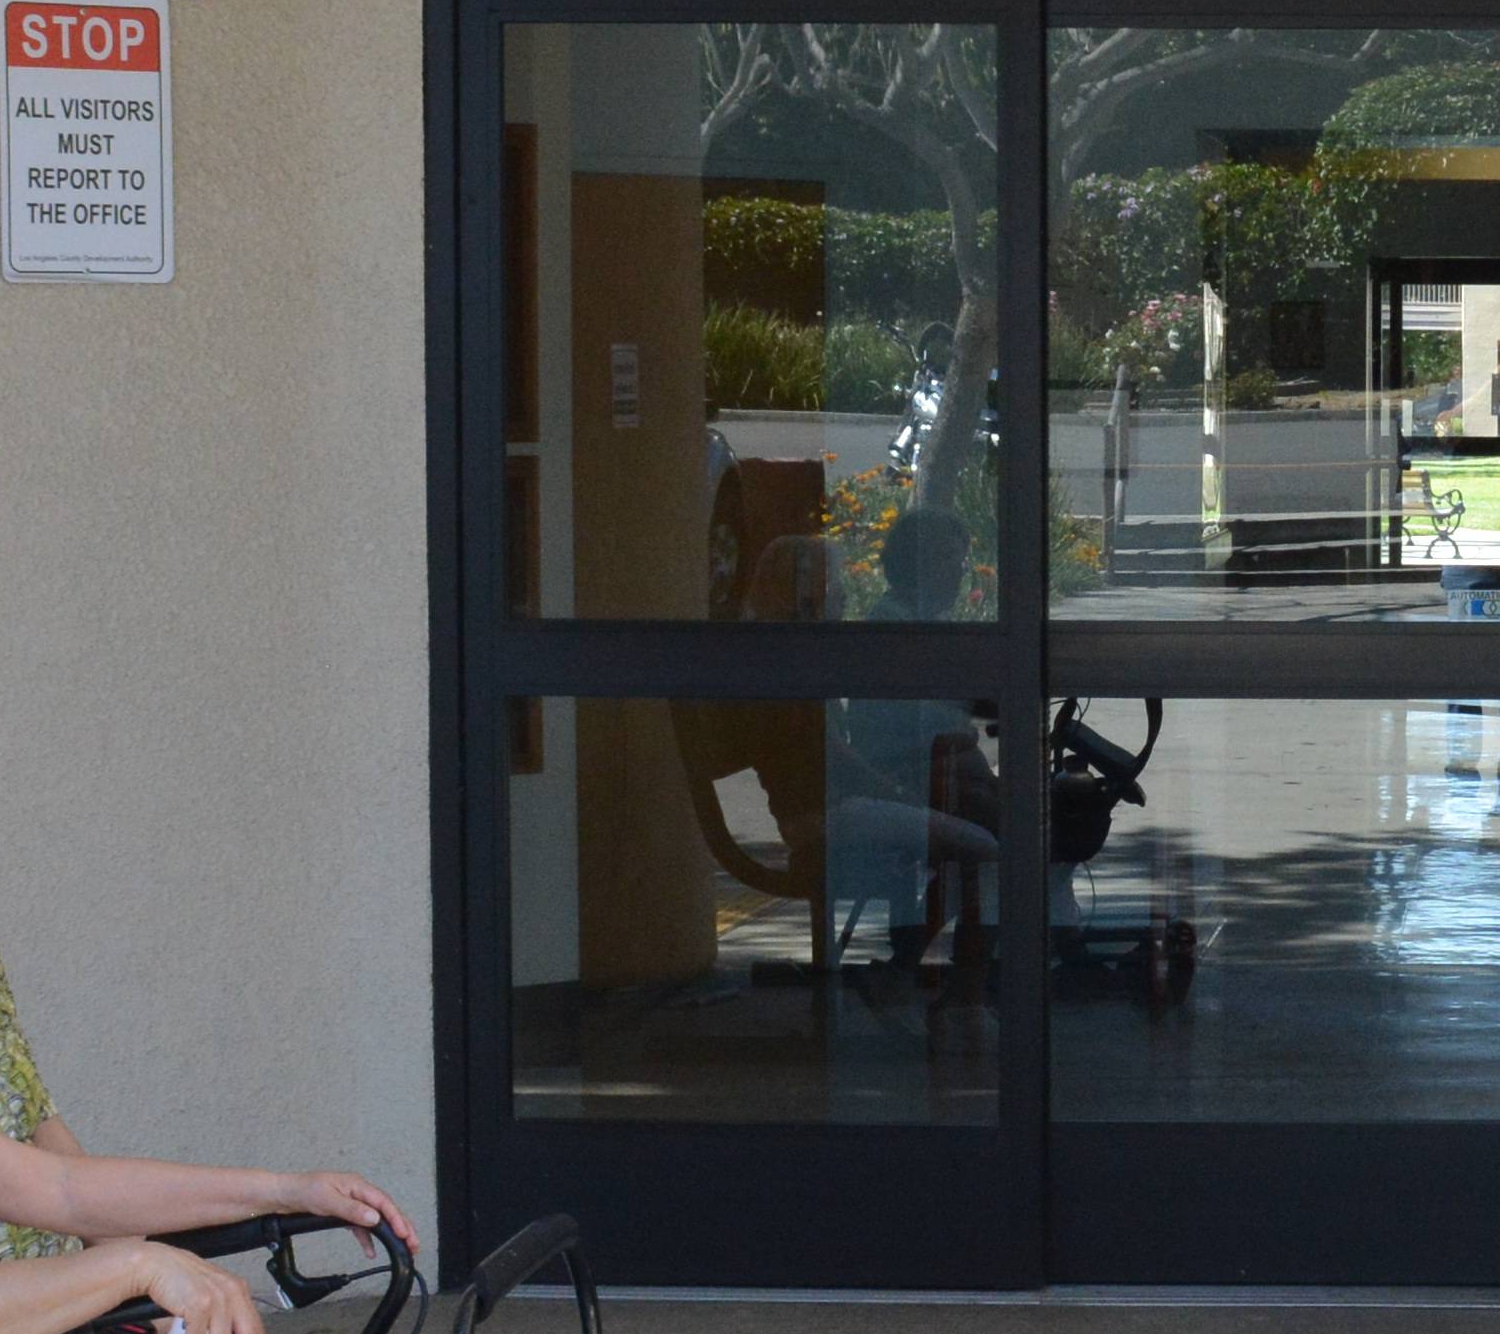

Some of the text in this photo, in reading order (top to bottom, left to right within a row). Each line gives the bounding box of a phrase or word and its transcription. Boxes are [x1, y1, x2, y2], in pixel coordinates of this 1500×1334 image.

[21, 14, 145, 62] STOP
[16, 97, 155, 121] ALL VISITORS
[58, 134, 114, 155] MUST
[28, 168, 145, 191] REPORT TO
[27, 203, 147, 225] THE OFFICE
